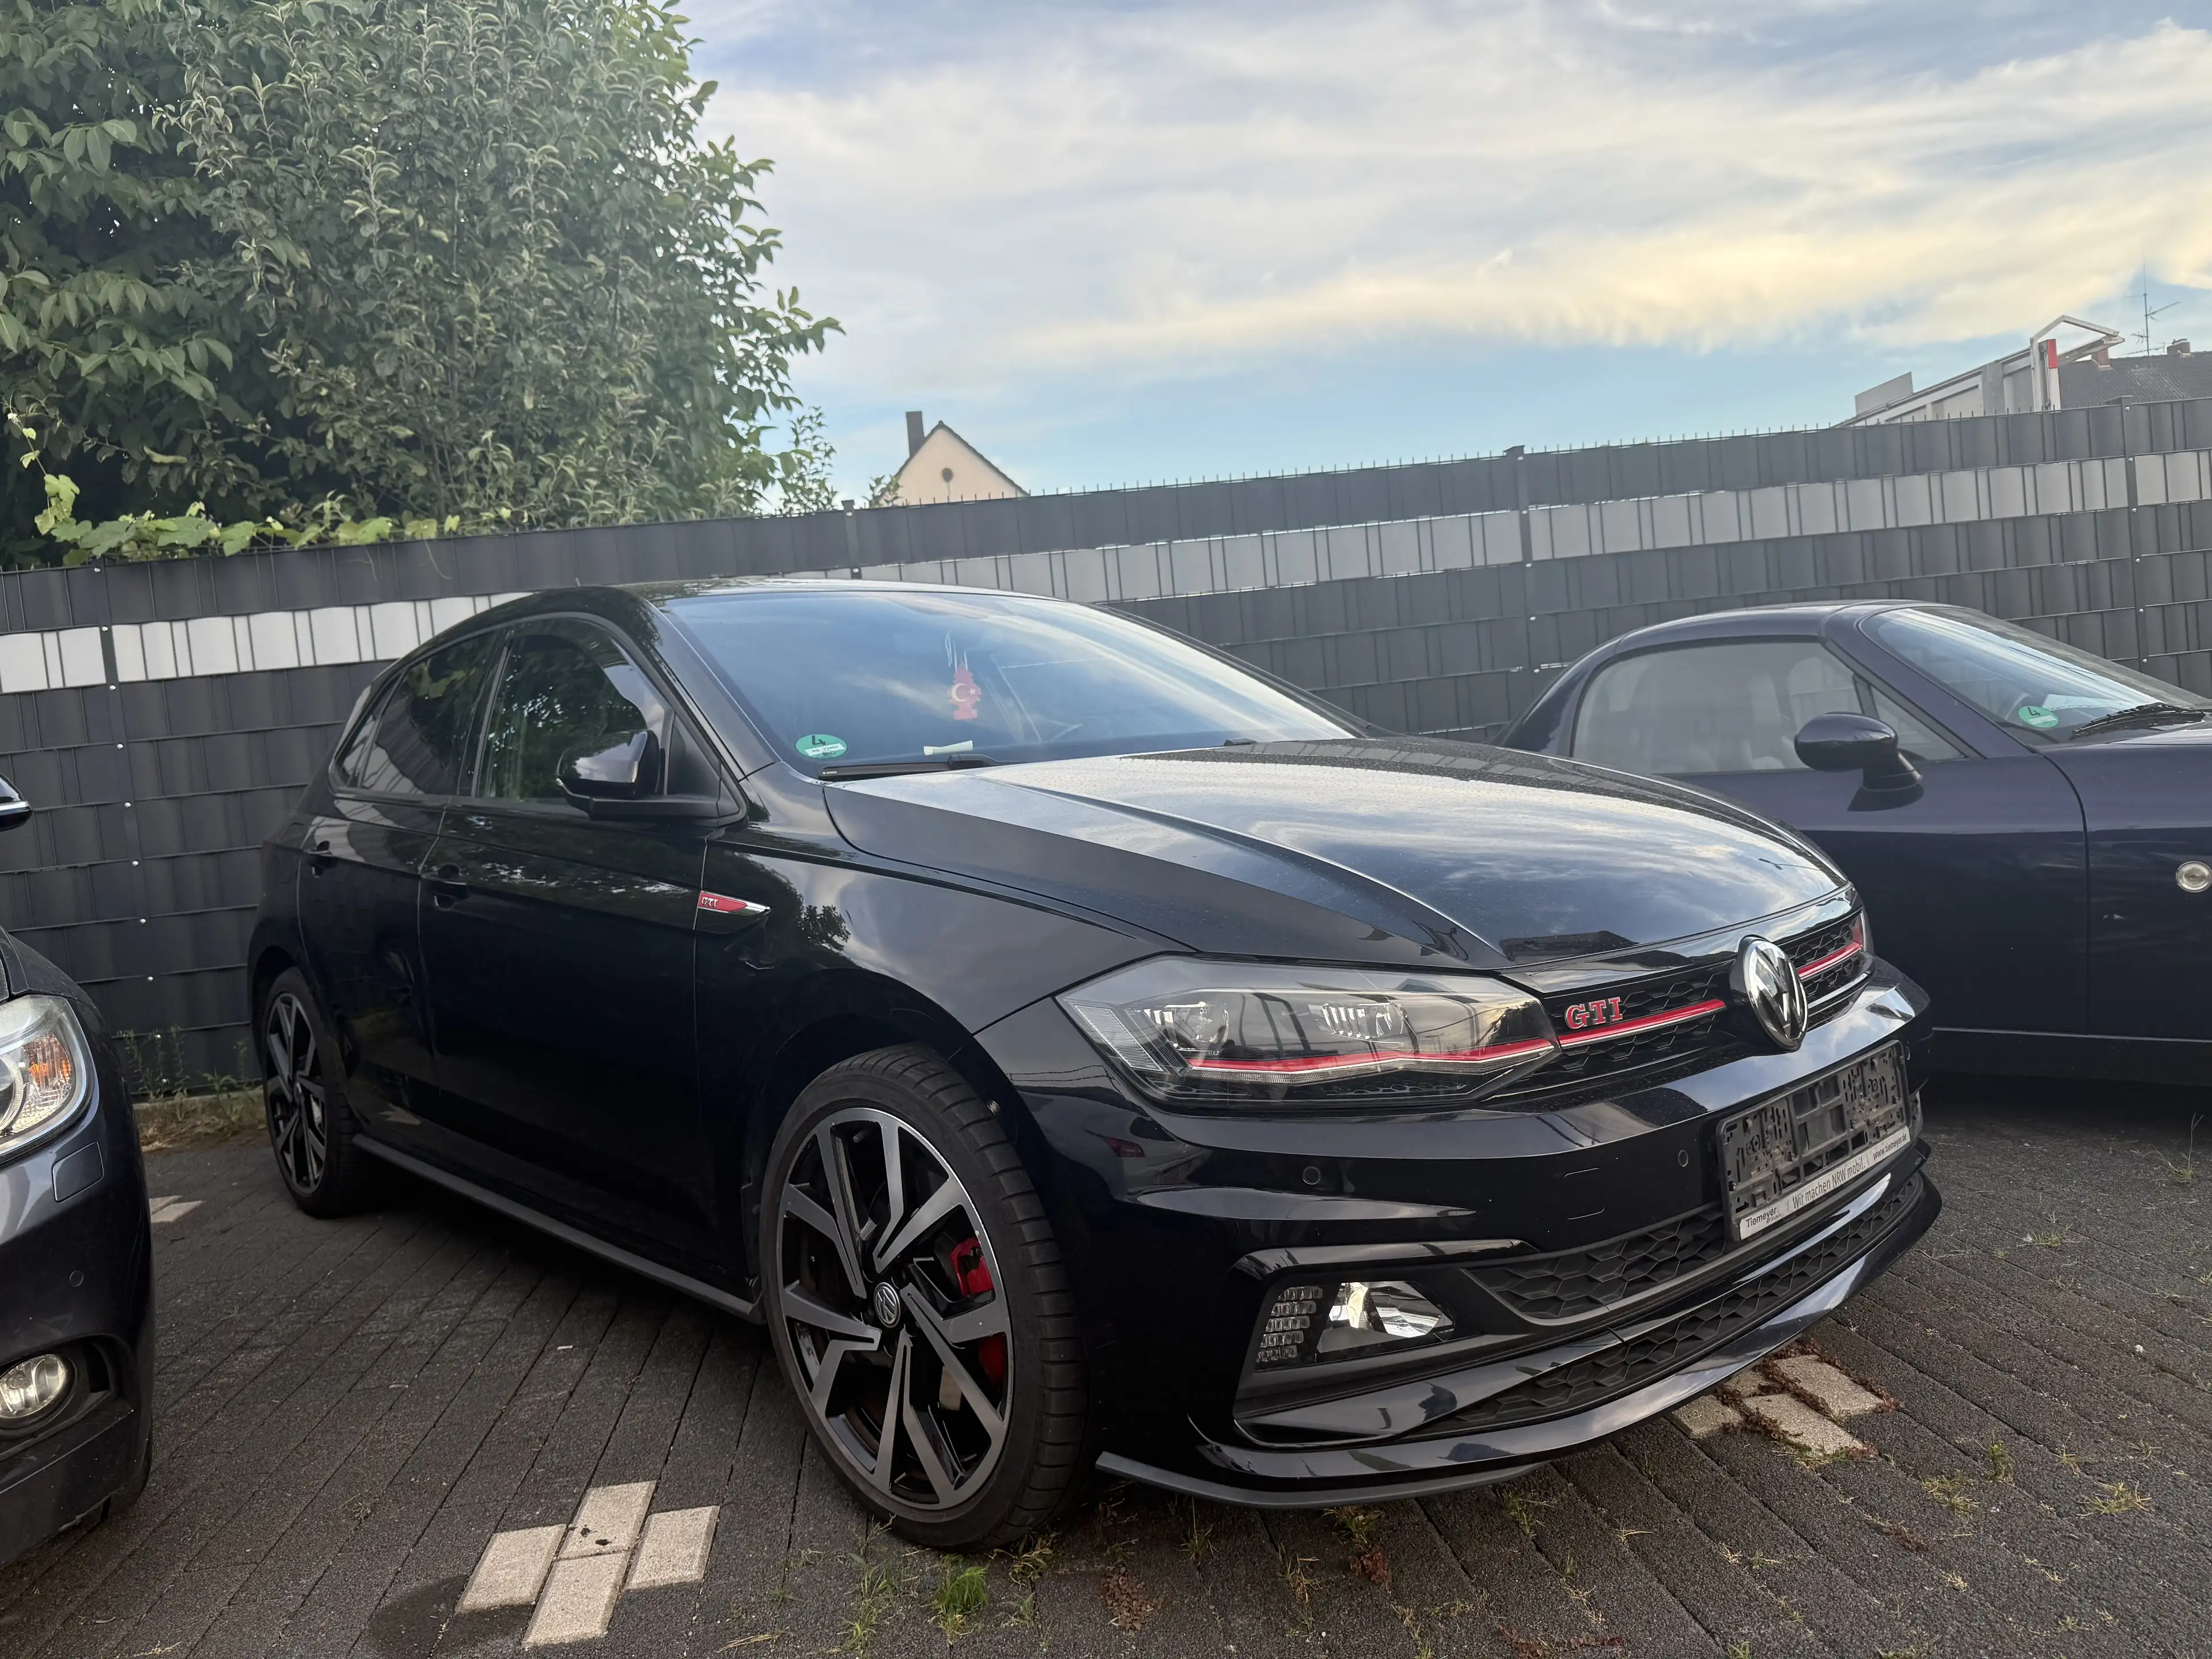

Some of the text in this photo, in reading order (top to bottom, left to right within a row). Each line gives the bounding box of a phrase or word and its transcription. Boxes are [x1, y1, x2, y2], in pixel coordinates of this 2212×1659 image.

[2027, 706, 2041, 717] 4
[812, 735, 826, 745] 4
[702, 896, 718, 907] GTI
[1565, 997, 1623, 1030] GTI
[1745, 1207, 1777, 1228] Tiemeyer
[1792, 1192, 1805, 1210] Wir
[1805, 1181, 1831, 1202] machen
[1832, 1168, 1847, 1187] NRW
[1847, 1157, 1866, 1178] mobil.
[1873, 1132, 1907, 1162] www.tiemeyer.de
